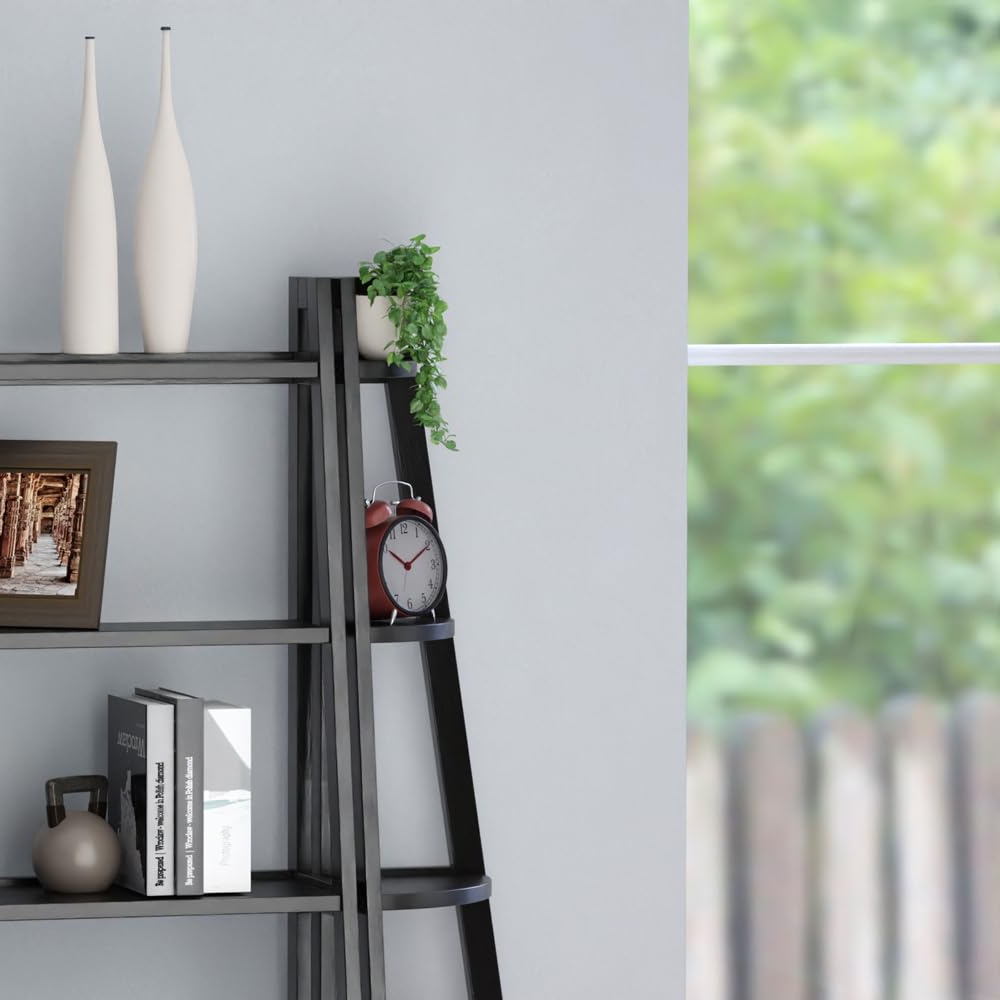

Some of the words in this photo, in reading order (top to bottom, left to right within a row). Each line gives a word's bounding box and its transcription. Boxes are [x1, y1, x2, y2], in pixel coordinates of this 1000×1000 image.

[400, 523, 408, 535] 12
[430, 559, 436, 570] 3
[428, 579, 434, 590] 4
[421, 592, 427, 603] 5
[407, 598, 413, 609] 6
